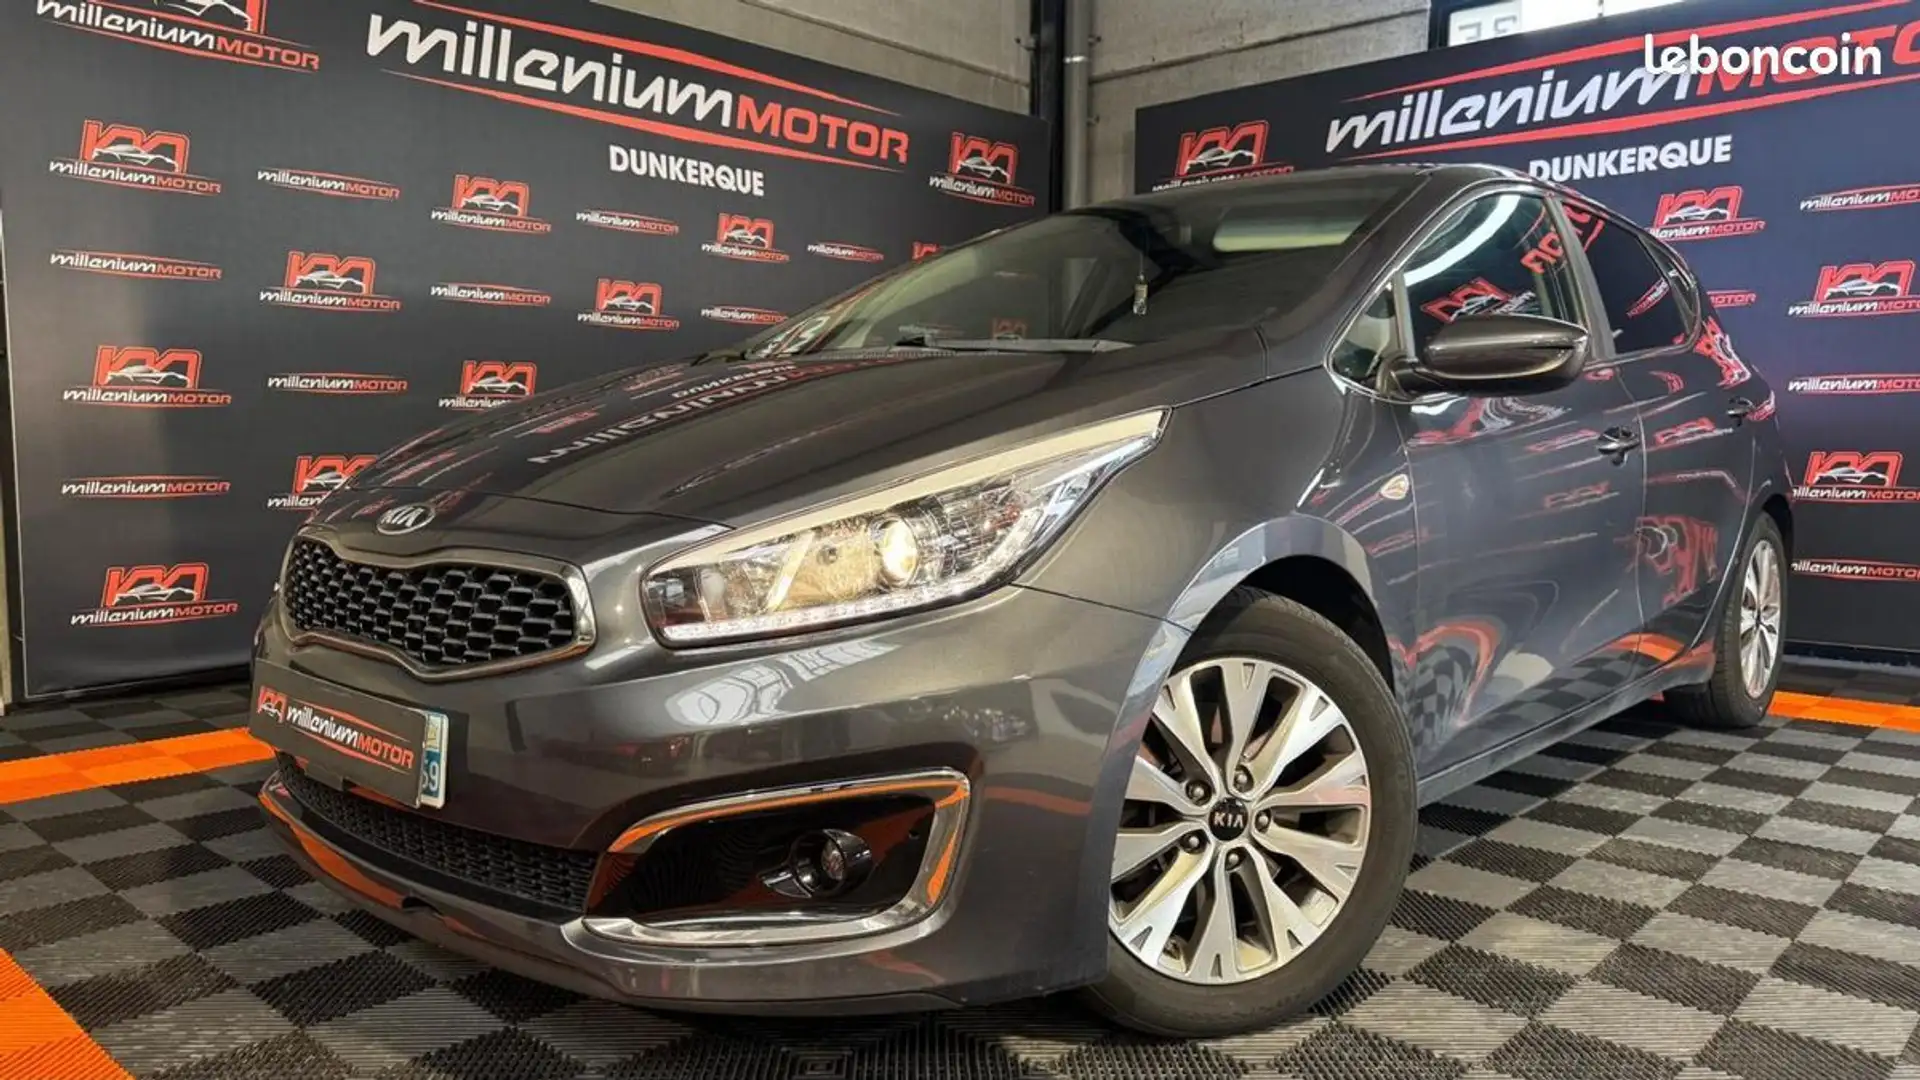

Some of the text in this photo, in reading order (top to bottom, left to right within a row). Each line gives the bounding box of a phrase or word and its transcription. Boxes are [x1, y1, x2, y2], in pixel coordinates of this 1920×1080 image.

[609, 144, 766, 197] DUNKERQUE
[1528, 134, 1733, 184] DUNKERQUE
[1213, 811, 1244, 829] KIA
